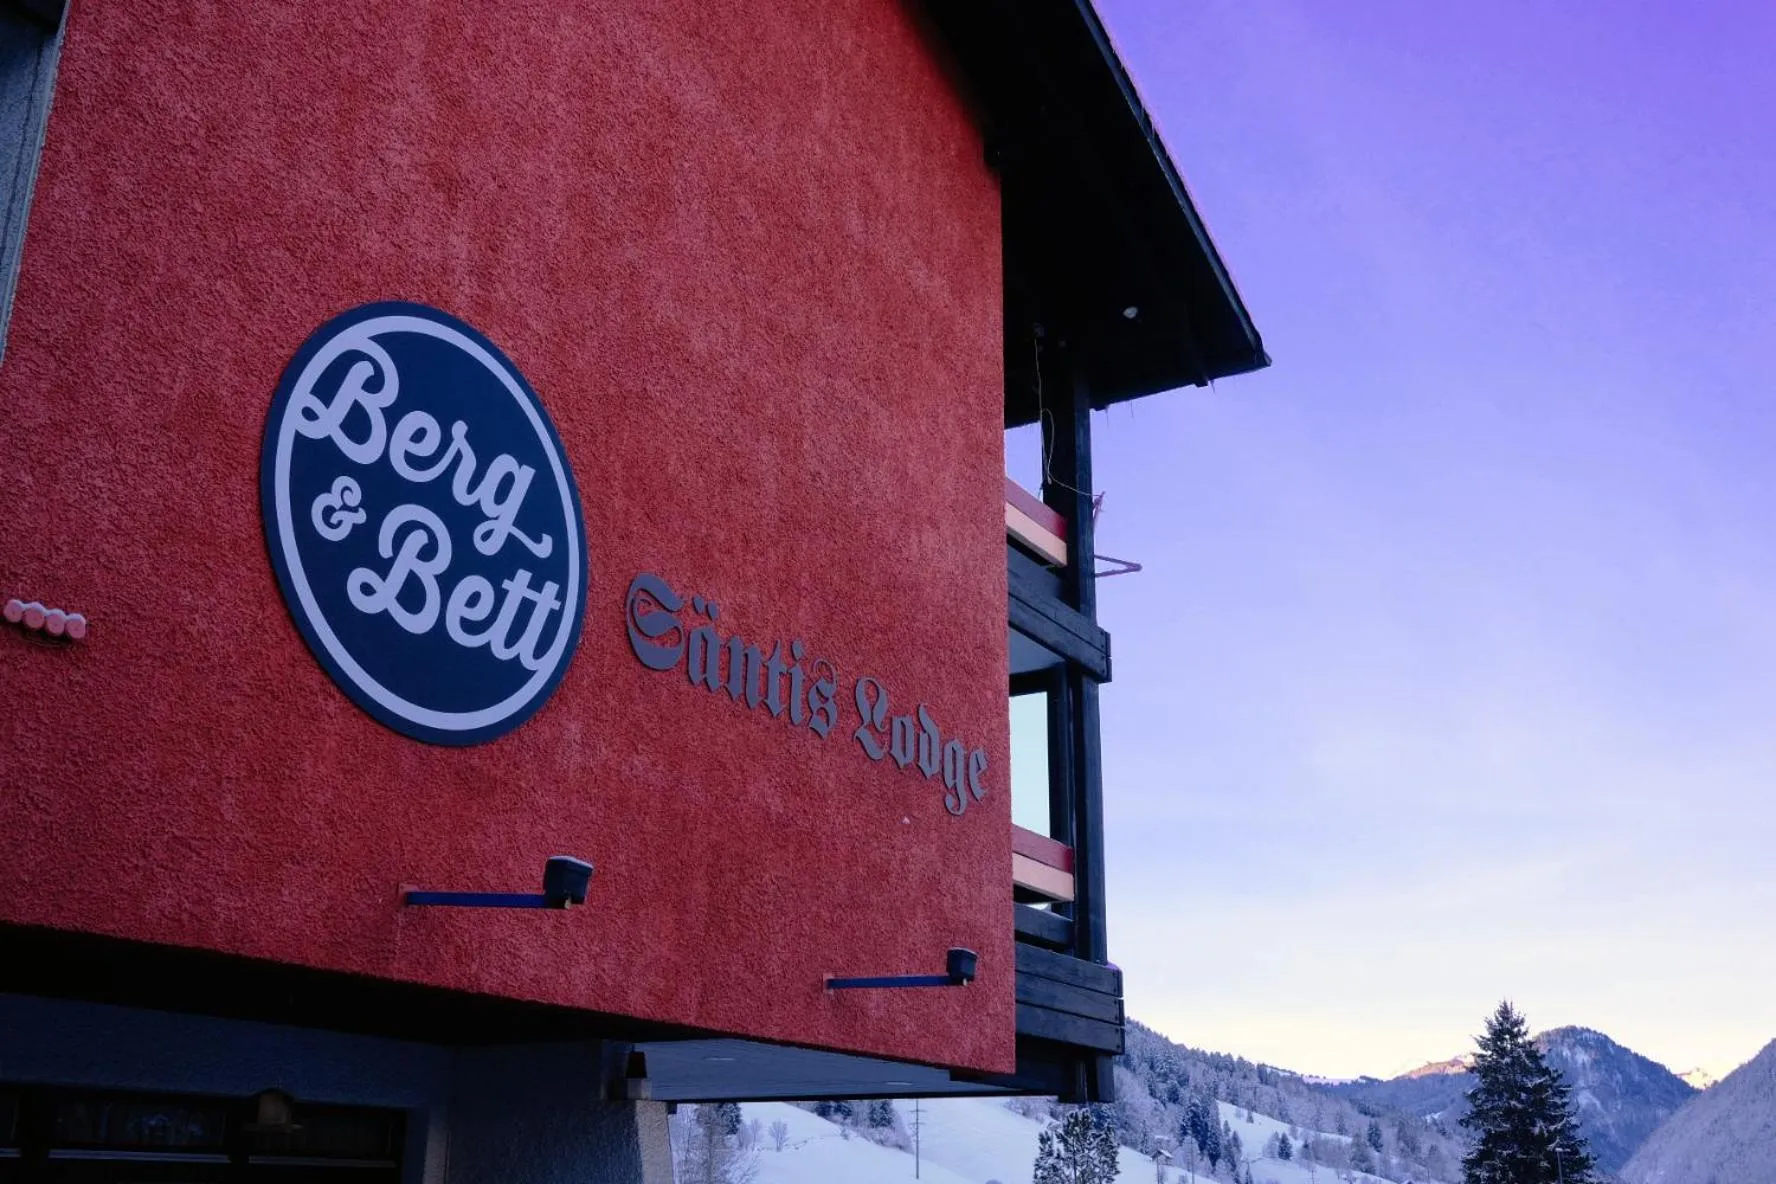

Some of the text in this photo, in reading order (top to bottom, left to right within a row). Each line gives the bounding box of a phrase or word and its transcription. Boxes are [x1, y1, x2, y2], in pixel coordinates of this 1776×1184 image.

[296, 336, 553, 559] Berg
[311, 475, 562, 671] & Bett
[626, 572, 989, 816] Säntis Lodge
